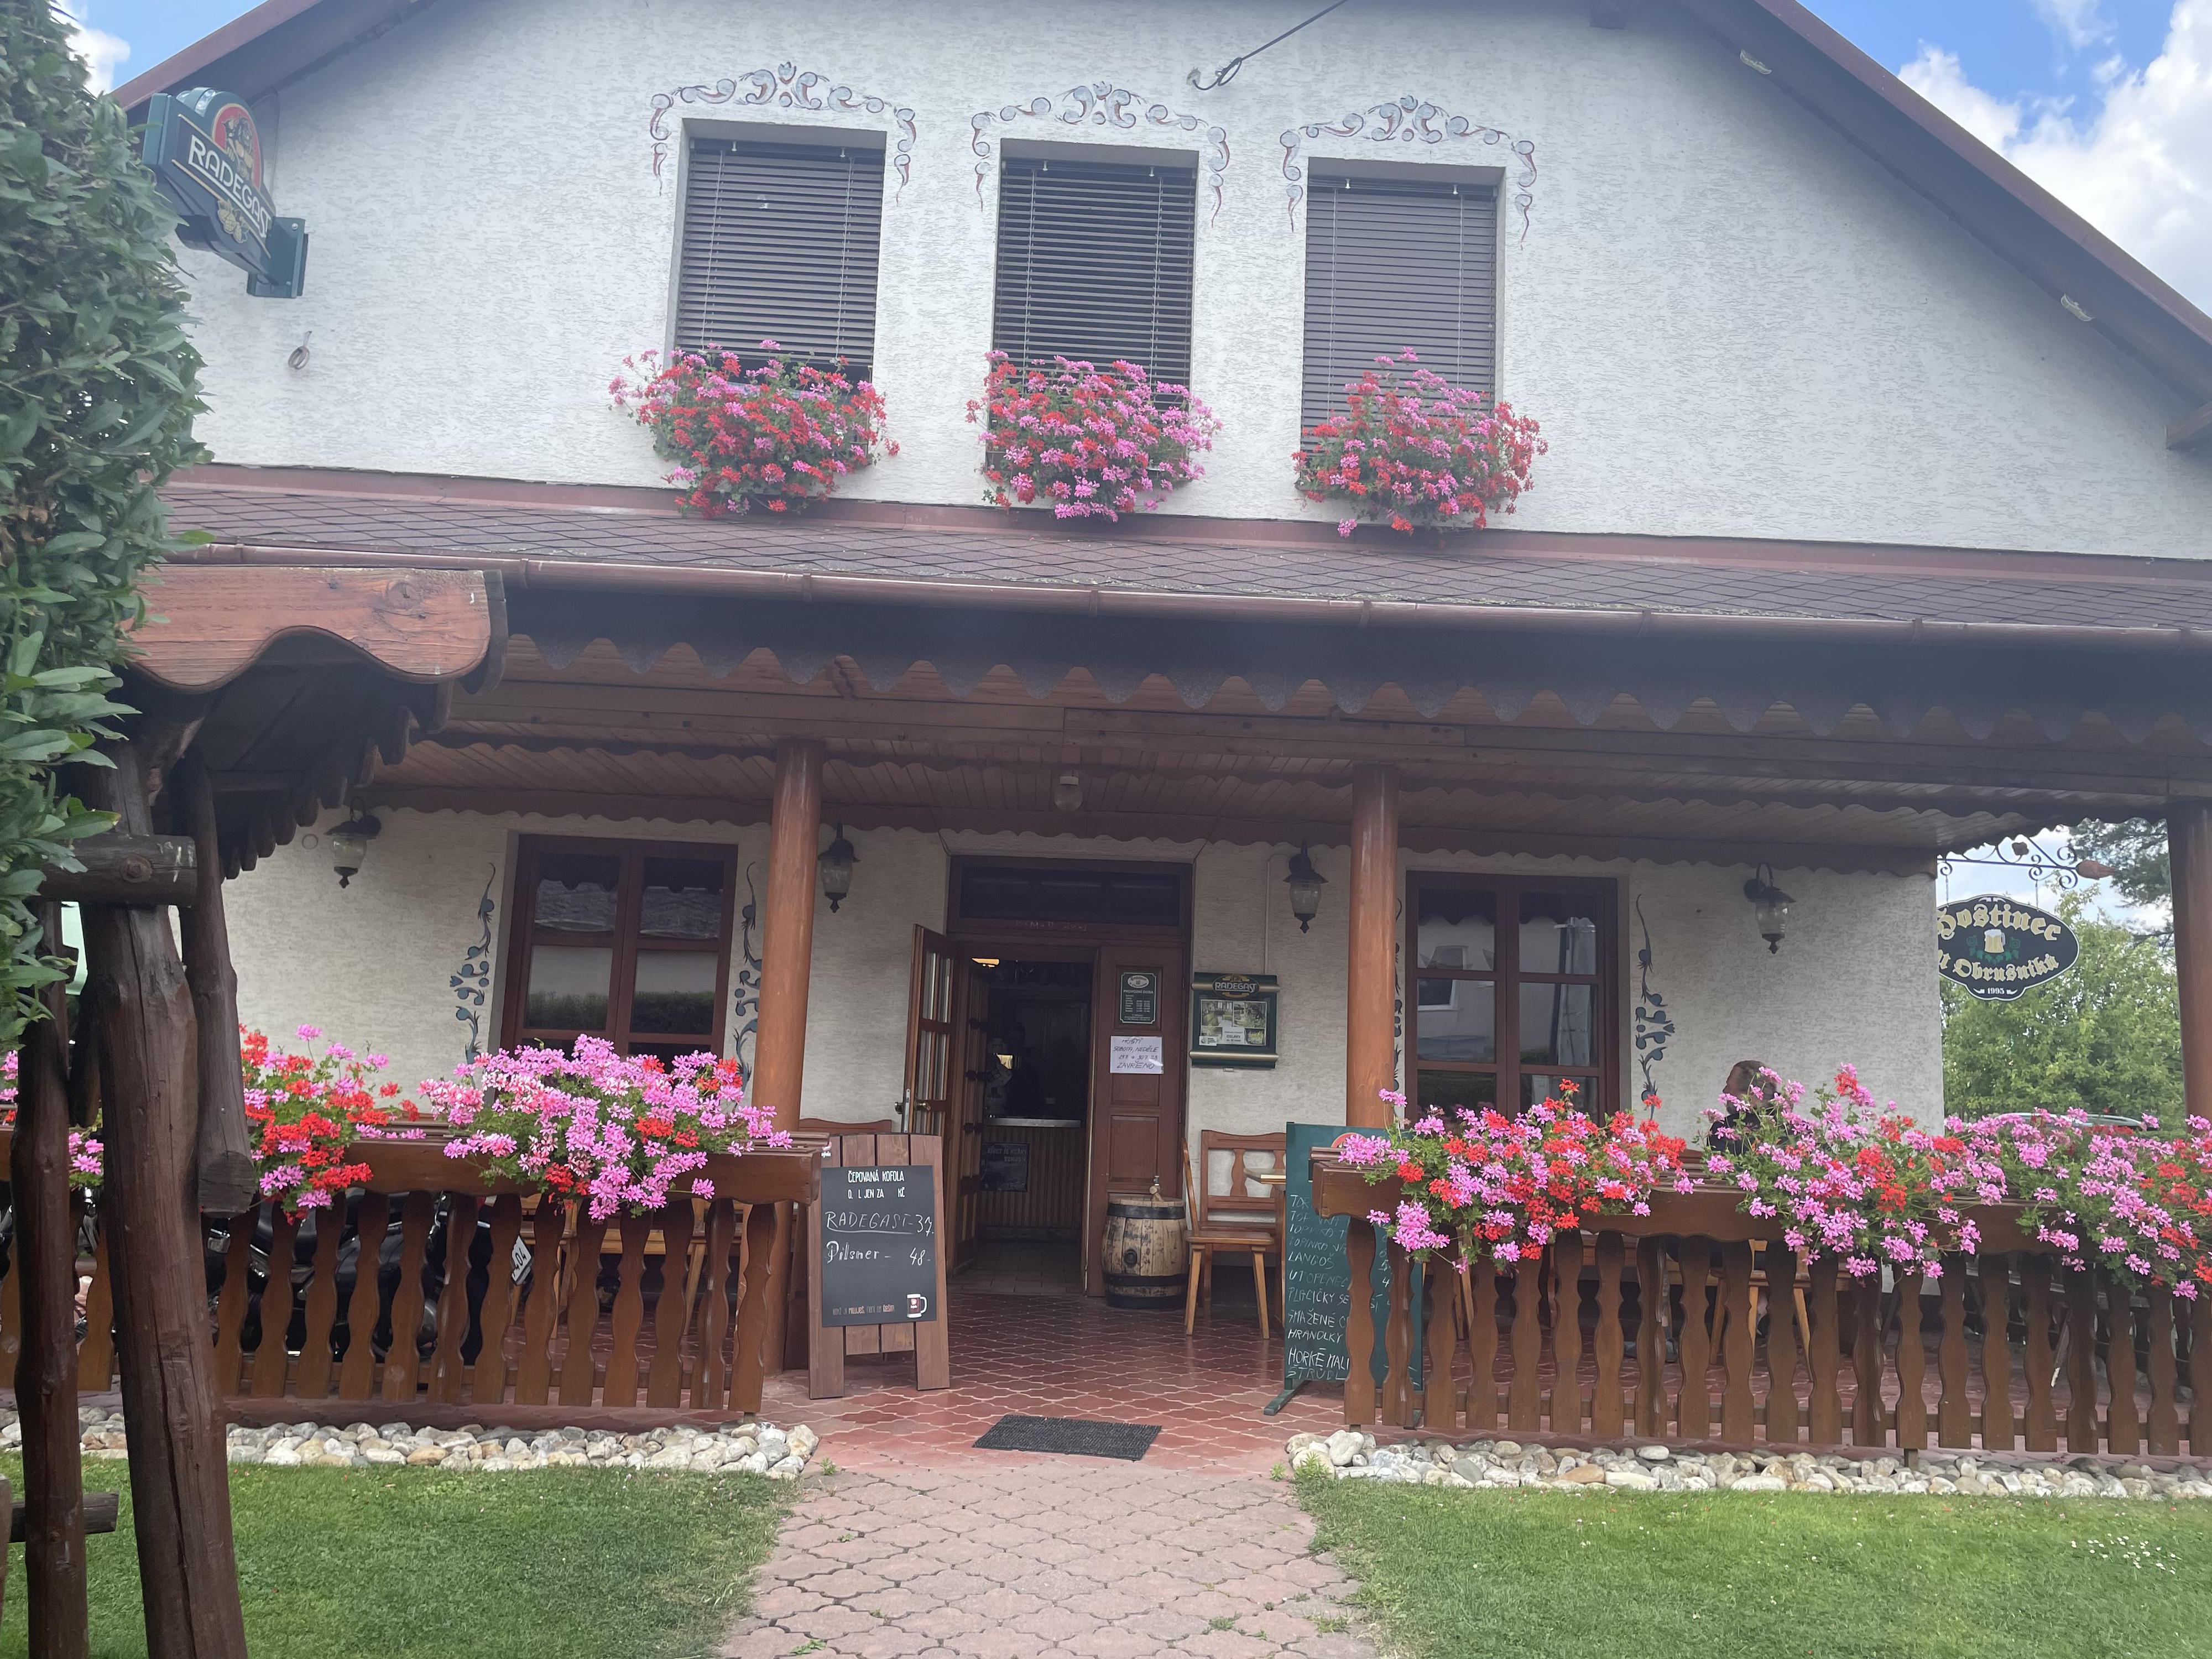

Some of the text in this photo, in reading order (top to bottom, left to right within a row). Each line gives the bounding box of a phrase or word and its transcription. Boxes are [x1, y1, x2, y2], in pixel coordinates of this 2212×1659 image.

[188, 134, 272, 238] RADEGAST
[1215, 982, 1256, 993] RADEGAST
[1117, 1060, 1155, 1070] ZAVŘENO
[848, 1169, 905, 1183] ČEPOVANÁ KOFOLA
[864, 1188, 874, 1199] JEN
[877, 1188, 885, 1198] ZA
[898, 1187, 905, 1198] KČ
[826, 1240, 880, 1264] Pilsner
[1288, 1251, 1335, 1270] LANGOŠ
[1287, 1329, 1343, 1343] HRANOLKY
